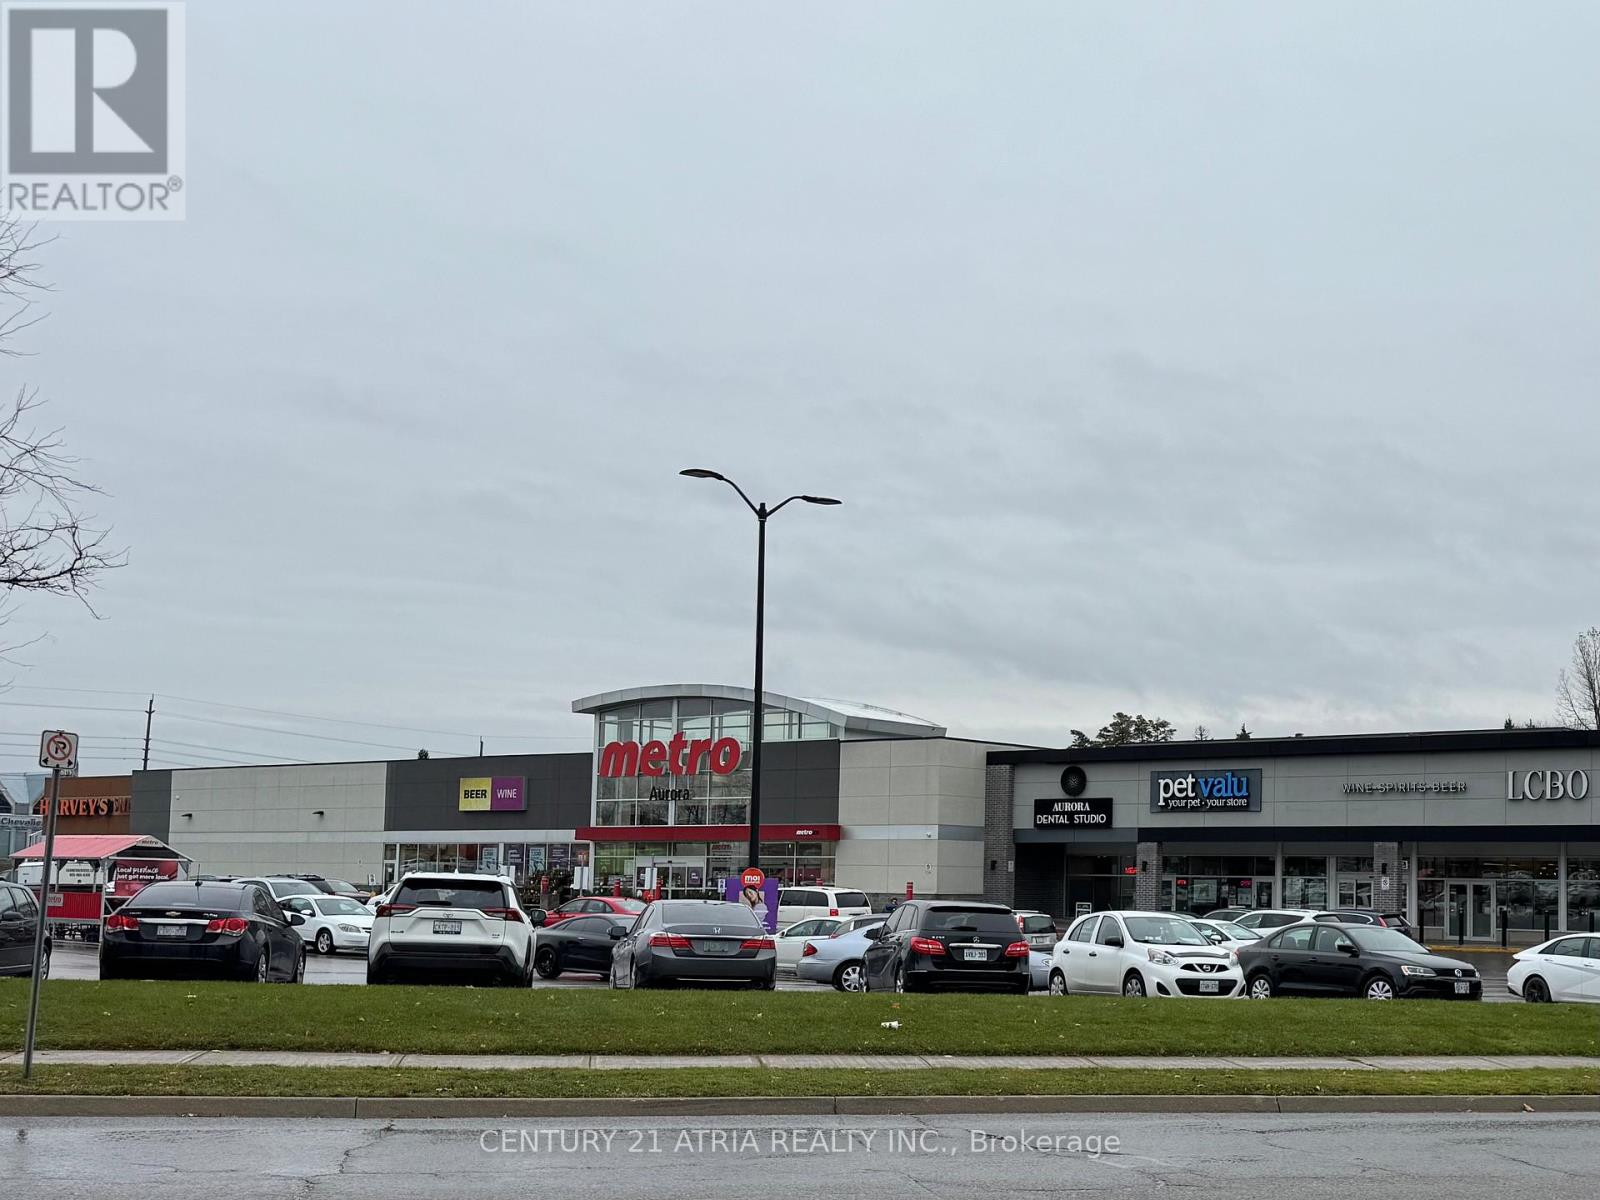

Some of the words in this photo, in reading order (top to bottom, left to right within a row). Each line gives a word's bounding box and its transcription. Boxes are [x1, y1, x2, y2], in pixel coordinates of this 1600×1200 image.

[599, 731, 743, 777] metro
[1158, 773, 1196, 806] pet
[1198, 772, 1248, 797] valu
[1342, 782, 1373, 793] WINE
[1378, 782, 1426, 793] SPIRITS
[1432, 781, 1467, 792] BEER
[1507, 769, 1589, 800] LCBO
[463, 789, 487, 799] BEER
[496, 788, 517, 799] WINE
[649, 786, 690, 801] Aurora
[40, 798, 109, 816] HRVEY'S
[1052, 802, 1090, 812] AURORA
[1168, 799, 1186, 809] your
[1187, 799, 1201, 809] pet
[1206, 798, 1225, 809] your
[1226, 798, 1247, 806] store
[1036, 814, 1070, 824] DENTAL
[1073, 813, 1107, 824] STUDIO
